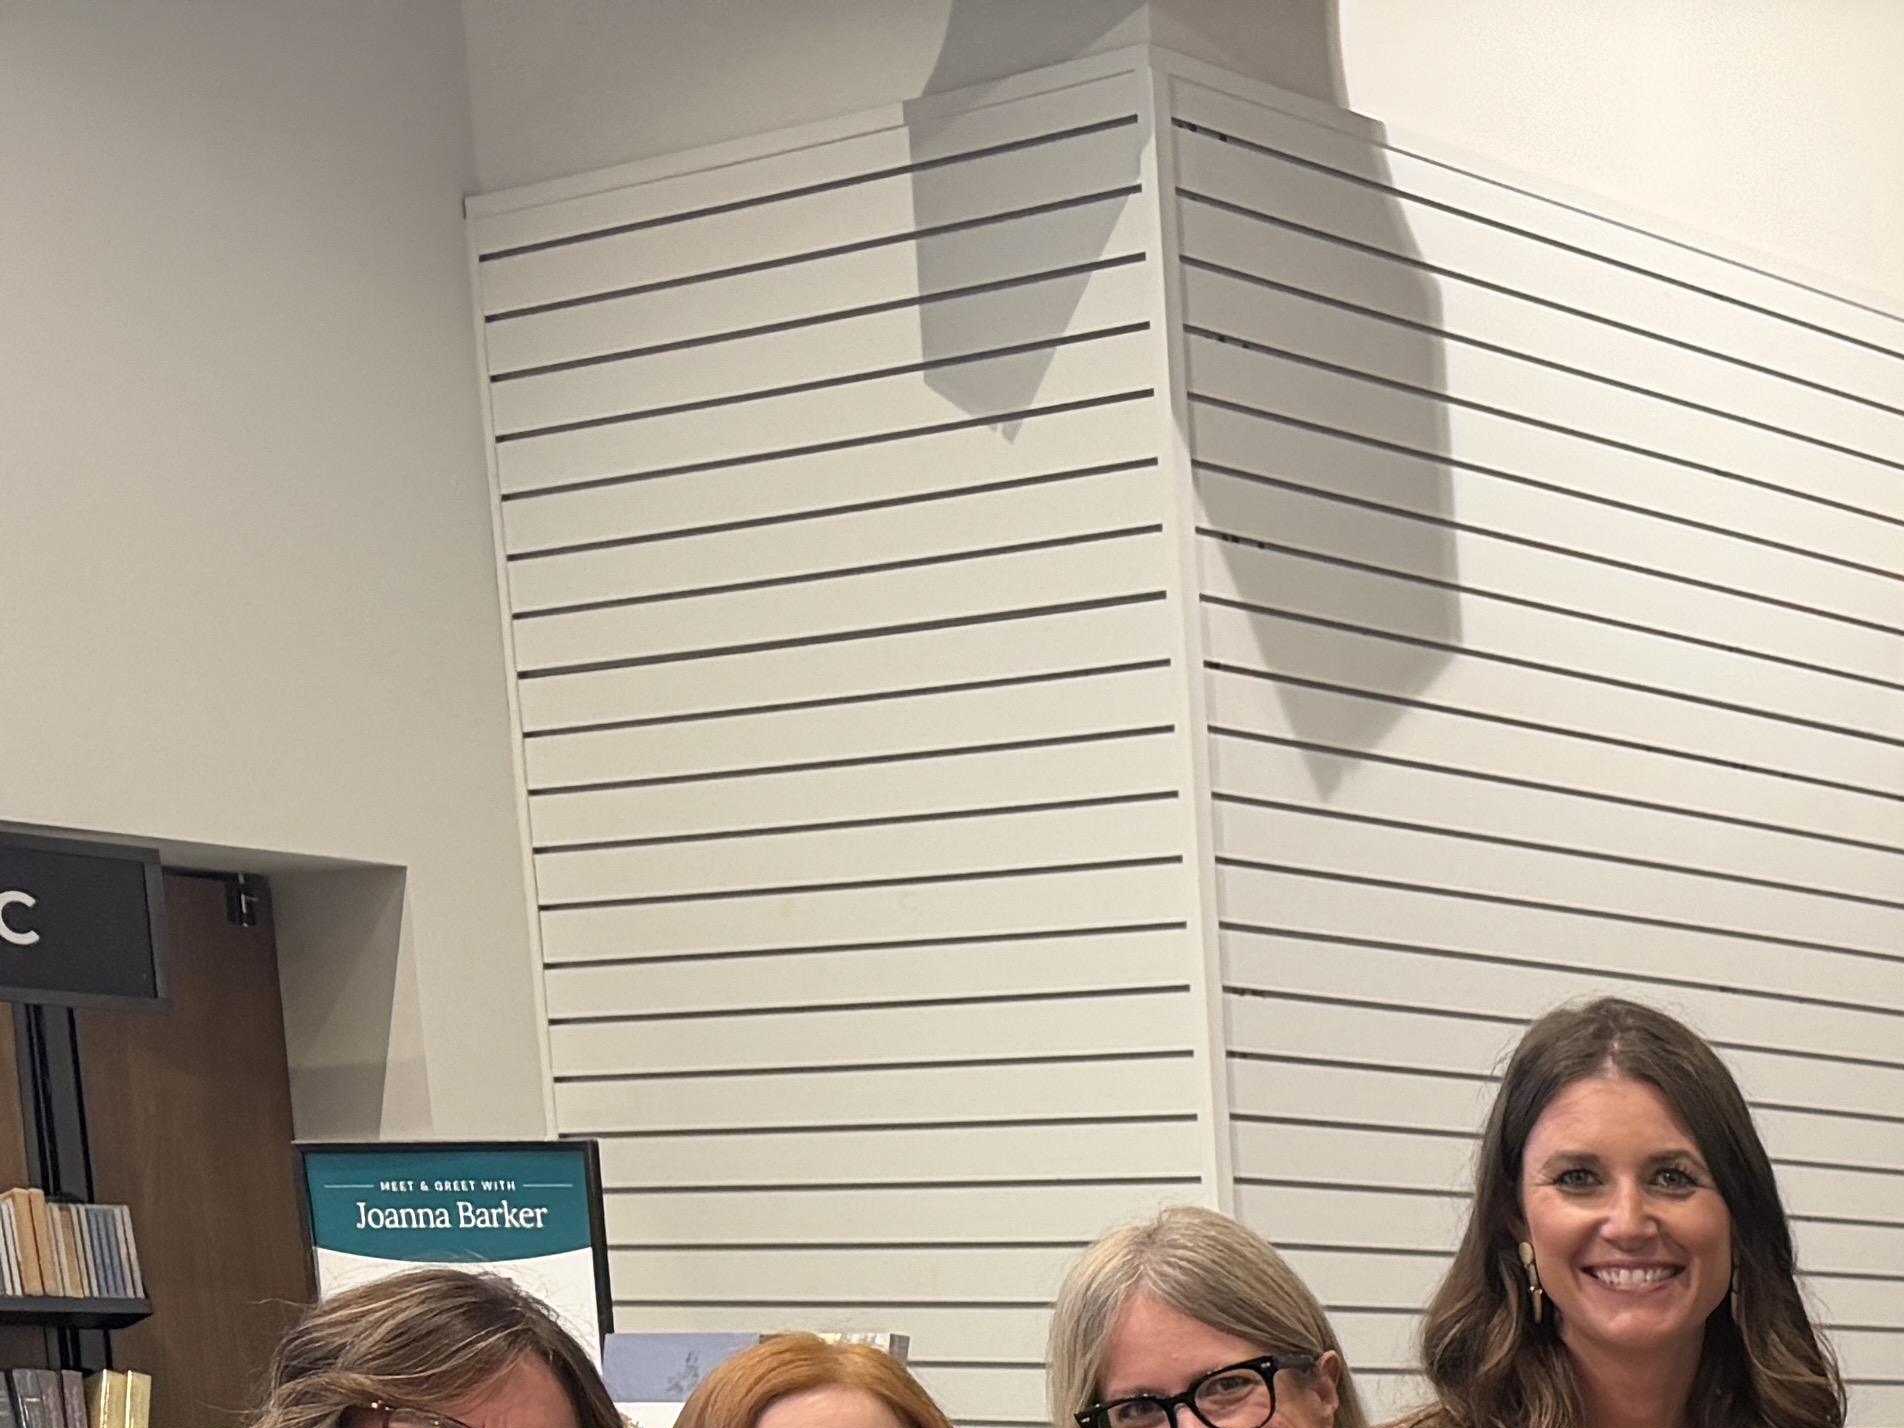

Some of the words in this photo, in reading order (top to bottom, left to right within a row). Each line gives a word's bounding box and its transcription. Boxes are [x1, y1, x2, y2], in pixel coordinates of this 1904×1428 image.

[0, 890, 40, 946] C
[380, 1181, 414, 1192] MEET
[434, 1181, 475, 1192] GREET
[482, 1181, 516, 1191] WITH
[356, 1202, 452, 1229] Joanna
[457, 1200, 548, 1228] Barker
